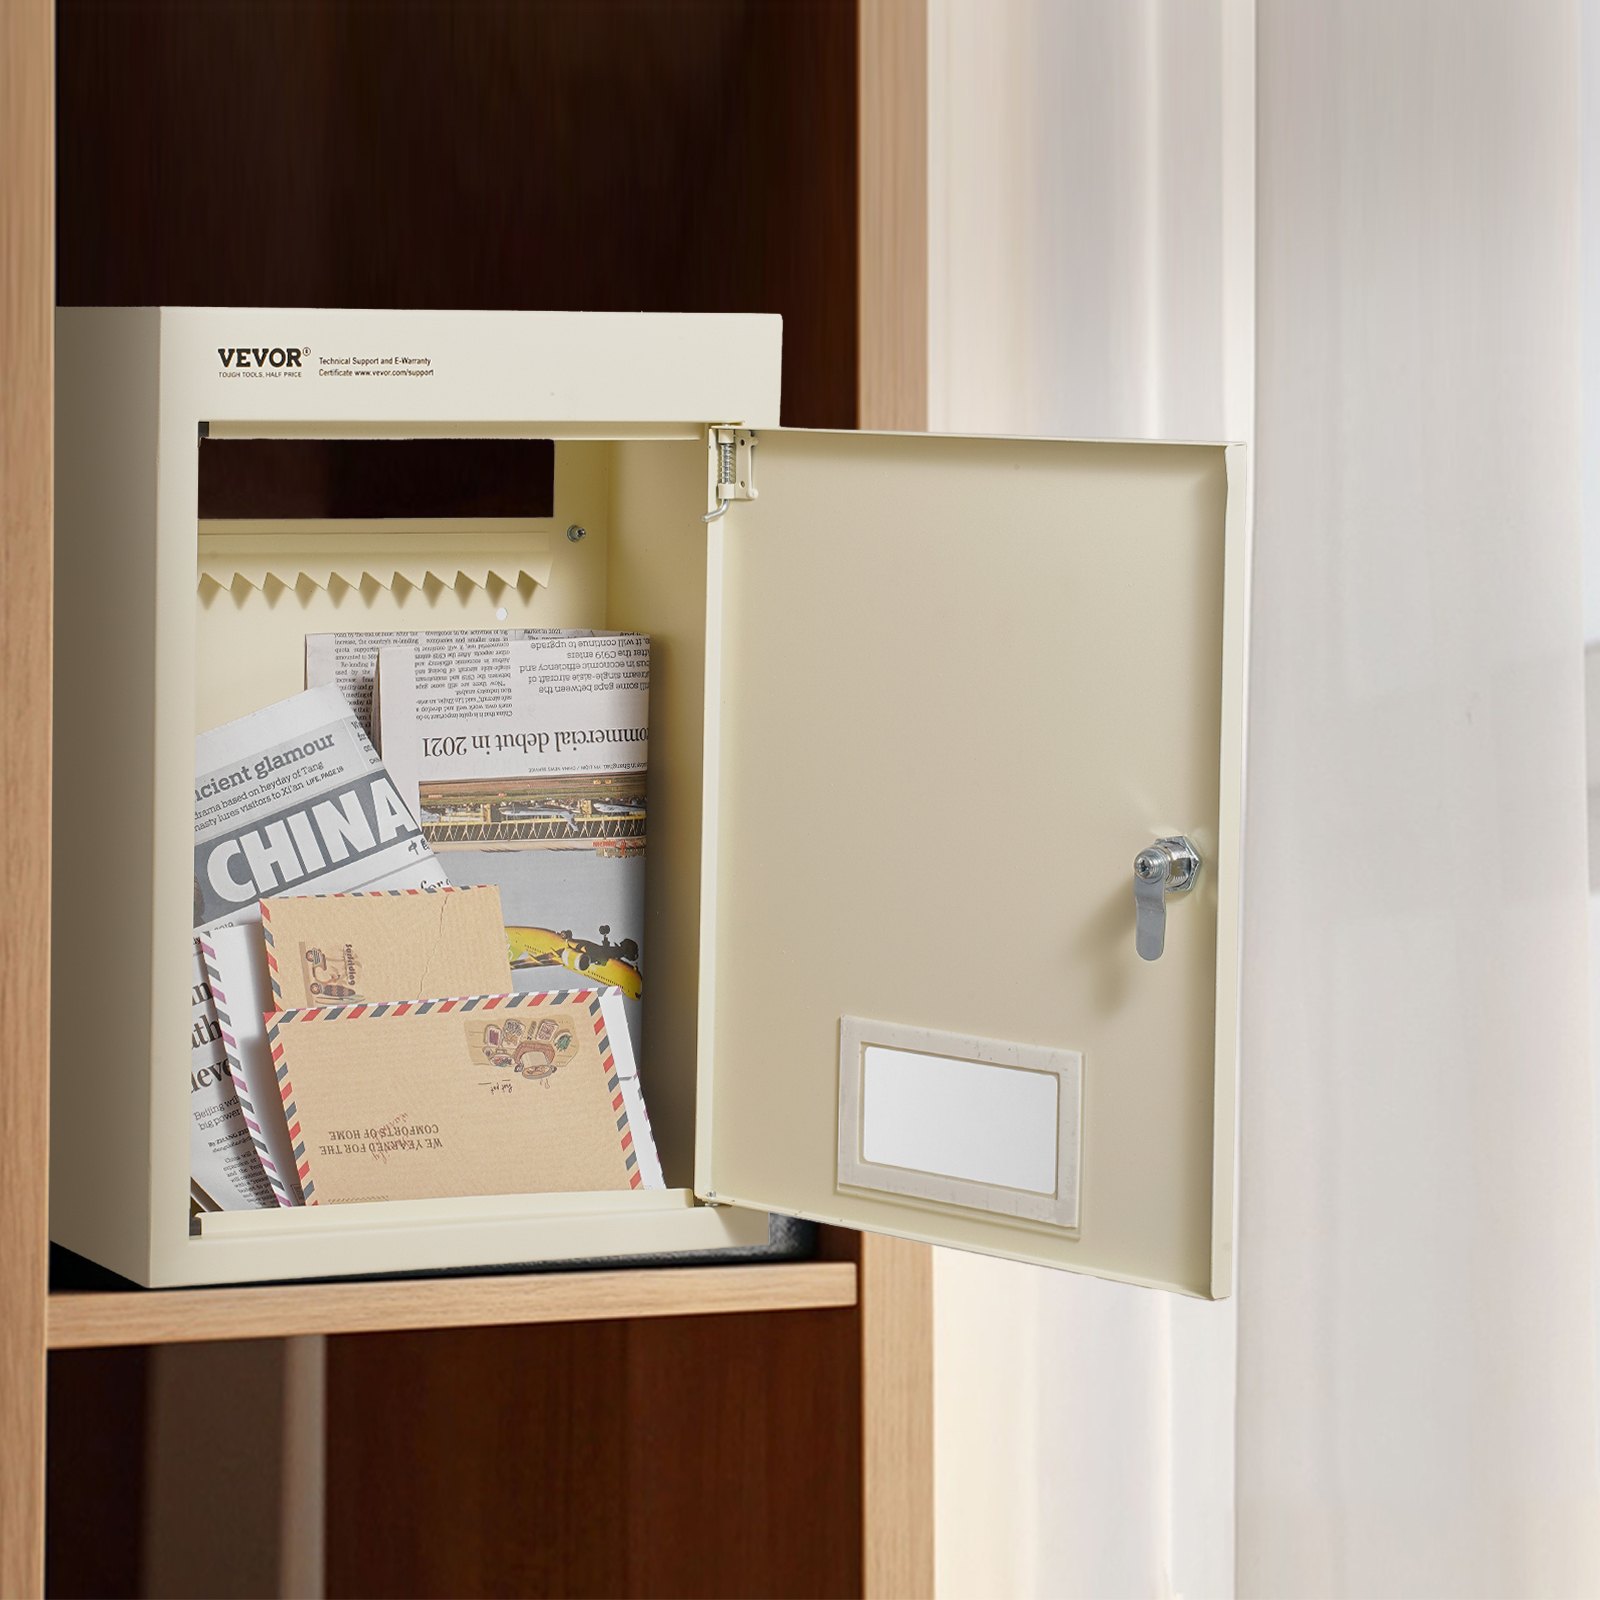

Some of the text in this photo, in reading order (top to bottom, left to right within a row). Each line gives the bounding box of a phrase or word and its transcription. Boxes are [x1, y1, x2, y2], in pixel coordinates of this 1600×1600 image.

[218, 348, 302, 368] VEVOR
[319, 357, 431, 367] Technical Support and E-Warranty
[319, 369, 434, 378] Certificate www.vevor.com/support
[530, 640, 567, 651] upgrade
[568, 641, 577, 650] to
[578, 640, 617, 649] continue
[618, 638, 634, 648] will
[567, 652, 593, 660] enters
[595, 650, 617, 659] C919
[618, 650, 632, 658] the
[519, 665, 536, 674] and
[539, 662, 580, 672] efficiency
[582, 661, 625, 671] economic
[528, 676, 537, 684] of
[539, 675, 570, 684] aircraft
[572, 672, 621, 682] single-aisle
[539, 686, 554, 694] the
[555, 684, 593, 693] between
[594, 682, 614, 691] gaps
[421, 736, 467, 757] 2021
[471, 735, 490, 755] in
[495, 732, 549, 754] debut
[254, 734, 335, 780] glamour
[221, 792, 248, 808] based
[249, 788, 260, 798] on
[260, 775, 291, 792] heyday
[292, 770, 302, 780] of
[301, 761, 324, 775] Tang
[240, 796, 272, 813] visitors
[272, 792, 281, 800] to
[320, 769, 336, 780] PAGE
[207, 777, 418, 902] CHINA
[193, 1102, 225, 1121] Beijing
[198, 1109, 240, 1130] big power
[328, 1124, 439, 1140] COMFORTS OF HOME
[319, 1138, 443, 1155] WE YEARNED FOR THE
